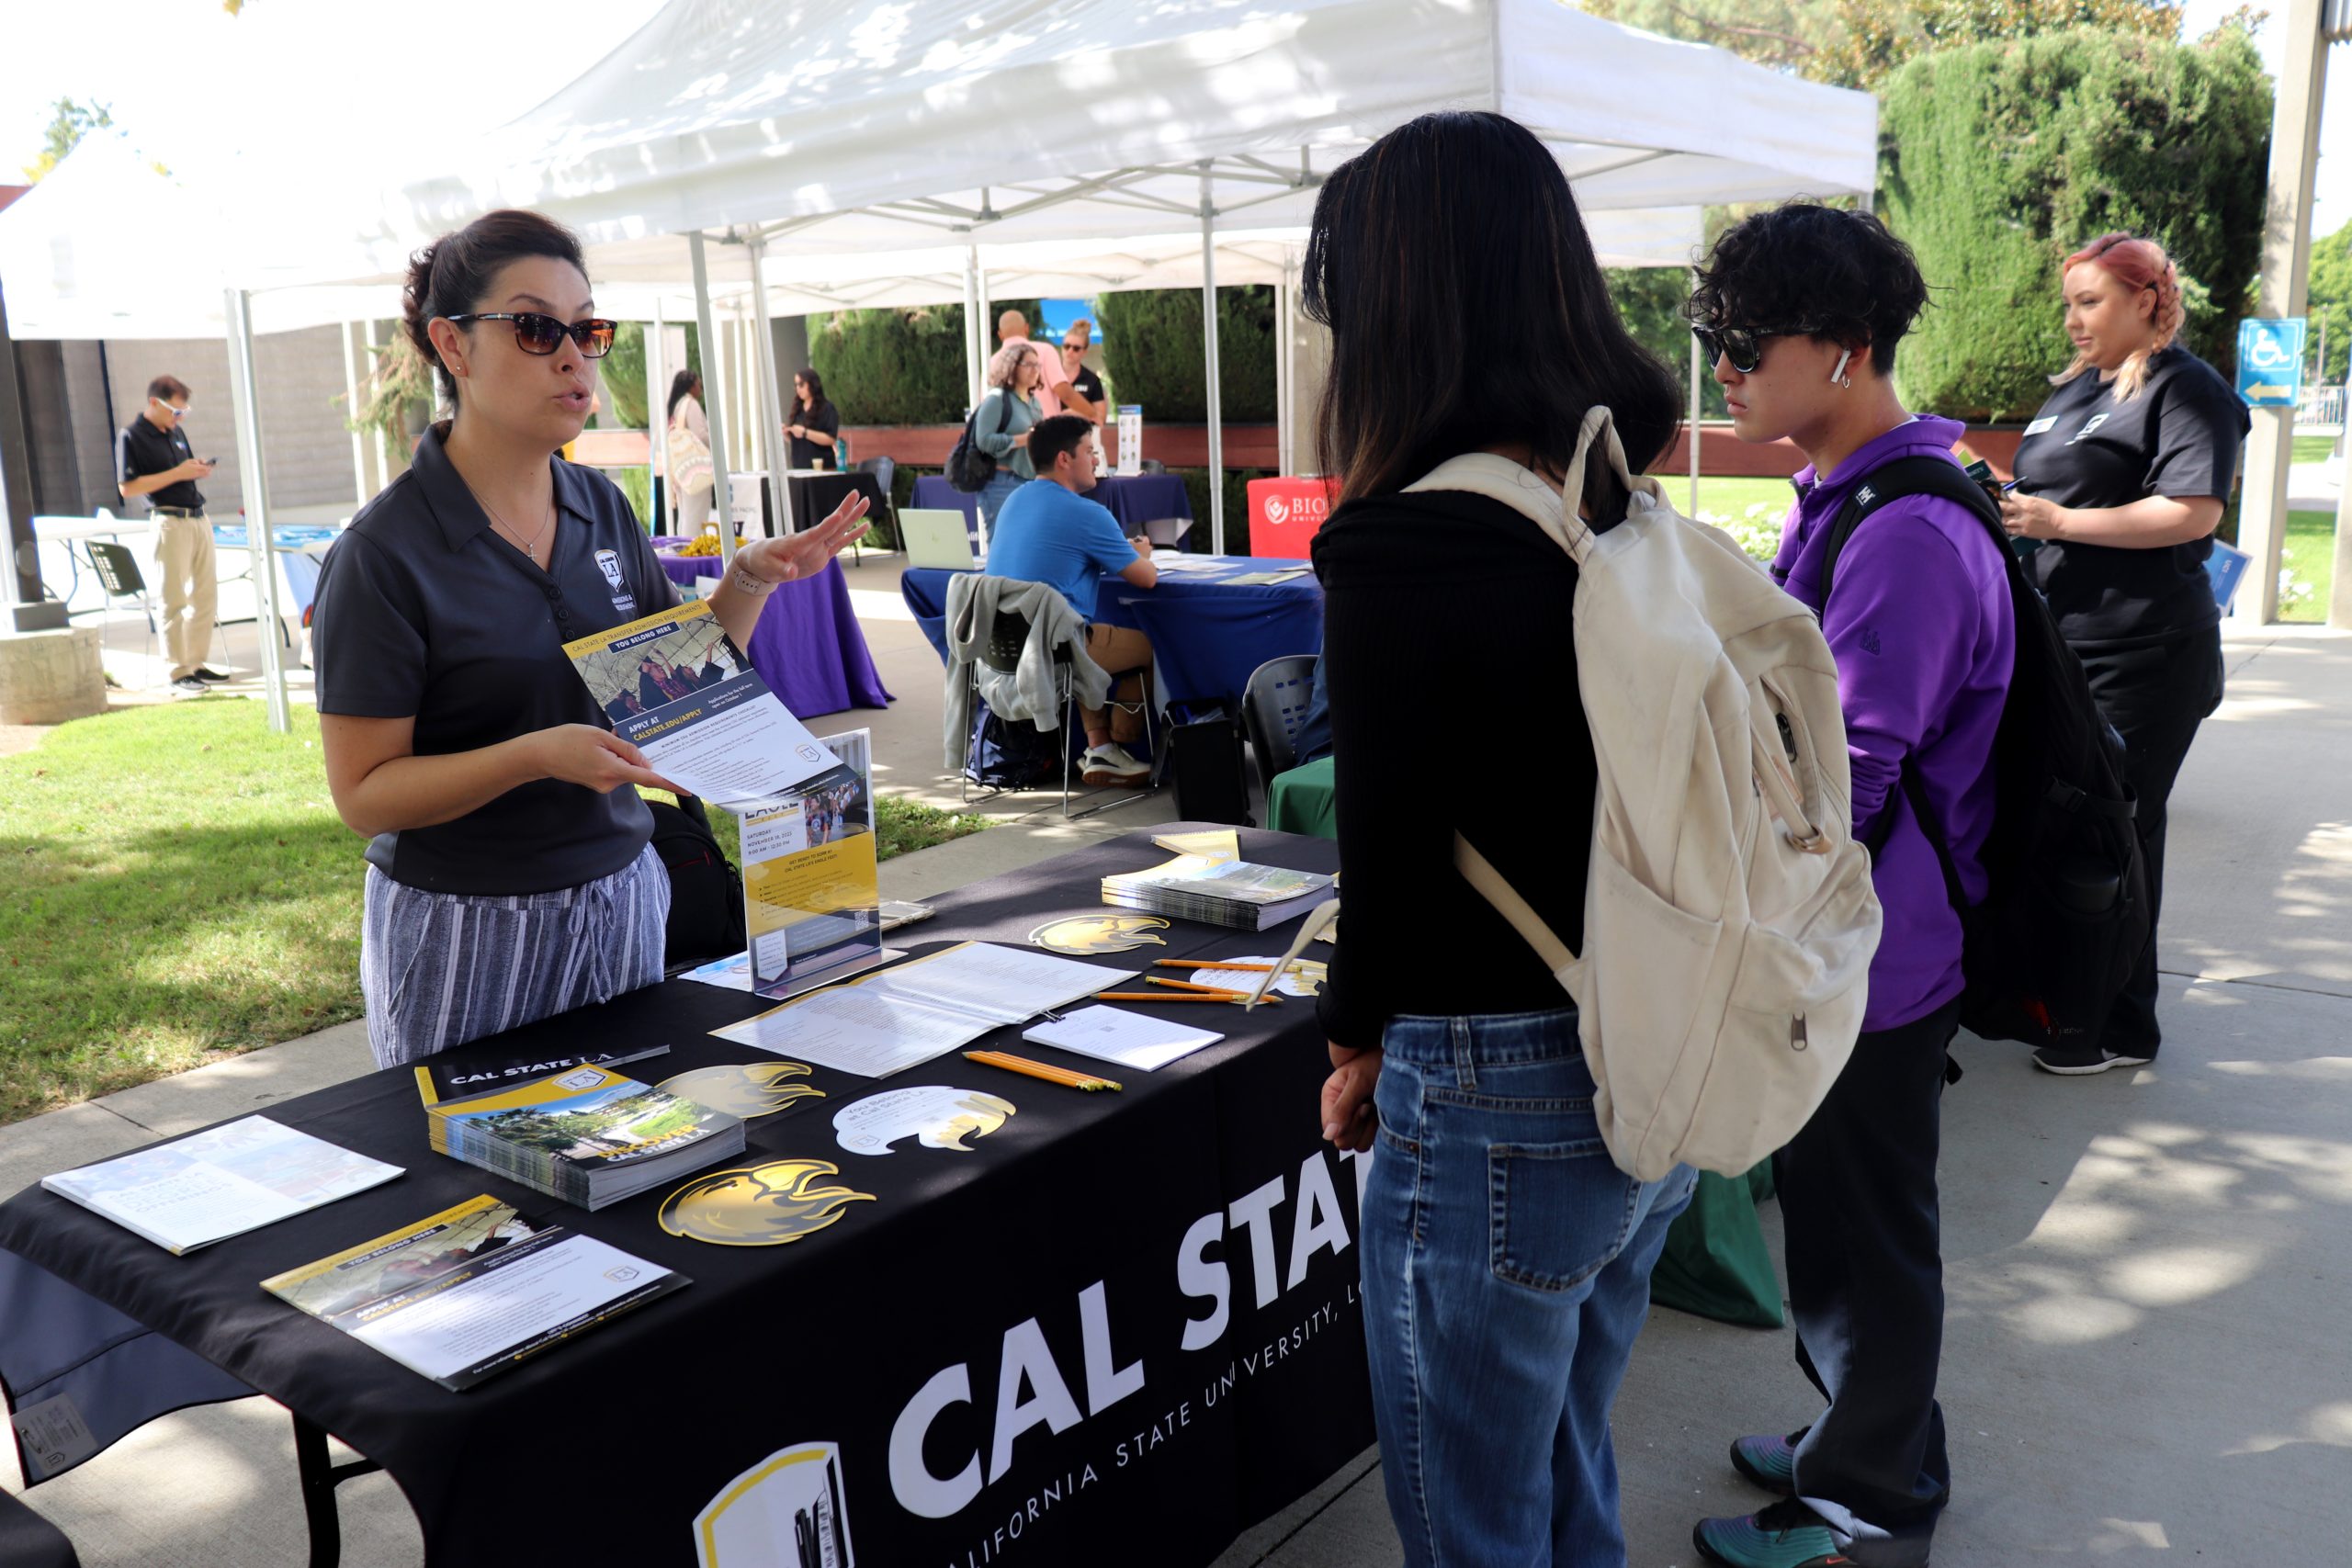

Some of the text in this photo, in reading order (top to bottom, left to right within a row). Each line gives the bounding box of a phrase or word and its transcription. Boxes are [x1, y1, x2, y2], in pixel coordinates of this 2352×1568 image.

[603, 563, 619, 577] LA
[572, 644, 585, 652] CAL
[583, 638, 599, 649] STATE
[606, 627, 633, 639] TRANSFER
[634, 618, 663, 631] ADMISSION
[662, 604, 703, 620] REQUIREMENTS
[615, 625, 673, 649] YOU BELONG HERE
[628, 716, 660, 734] APPLY AT
[633, 707, 703, 741] CALSTATE.EDU/APPLY
[747, 829, 772, 840] SATURDAY
[747, 836, 774, 848] NOVEMBER
[450, 1054, 615, 1085] CAL STATE LA
[845, 1090, 911, 1114] You Belong
[860, 1107, 881, 1115] Cal
[880, 1097, 910, 1108] State
[598, 1124, 699, 1158] DISCOVER
[606, 1128, 711, 1162] CAL STATE LA
[348, 1228, 437, 1267] YOU BELONG HERE
[356, 1294, 407, 1319] APPLY AT
[888, 1279, 1145, 1518] CAL
[1115, 1402, 1193, 1468] STATE
[1204, 1301, 1340, 1408] UNIVERSITY,
